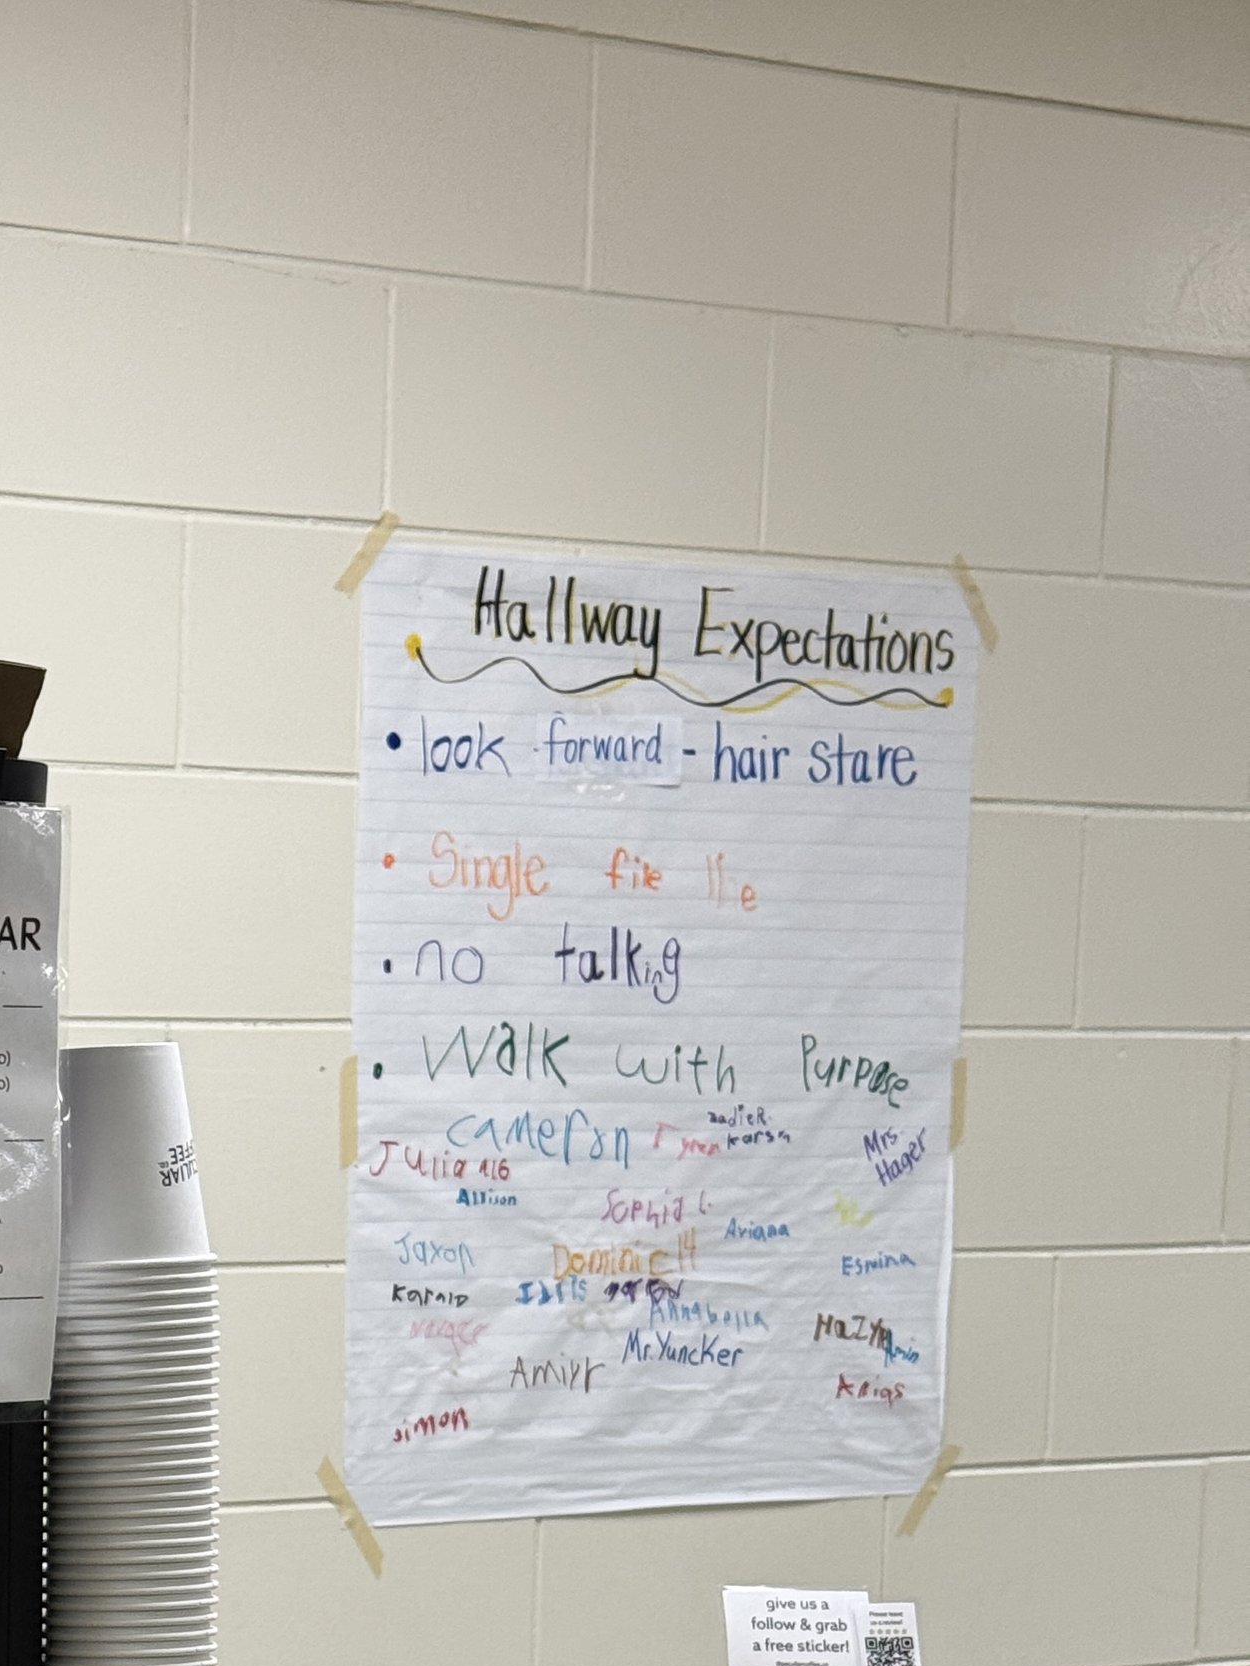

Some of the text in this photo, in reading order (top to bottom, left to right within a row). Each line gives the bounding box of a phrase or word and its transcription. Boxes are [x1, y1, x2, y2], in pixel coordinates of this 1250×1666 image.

[473, 566, 955, 683] Hallway Expectations
[421, 714, 511, 776] look
[548, 714, 663, 765] forward
[712, 719, 791, 783] hair
[428, 830, 549, 921] Single
[415, 921, 681, 1004] no talking
[421, 1021, 911, 1109] Walk with Purpose
[751, 1616, 849, 1633] follow & grab
[765, 1596, 830, 1612] give us a
[752, 1638, 850, 1654] a free sticker!
